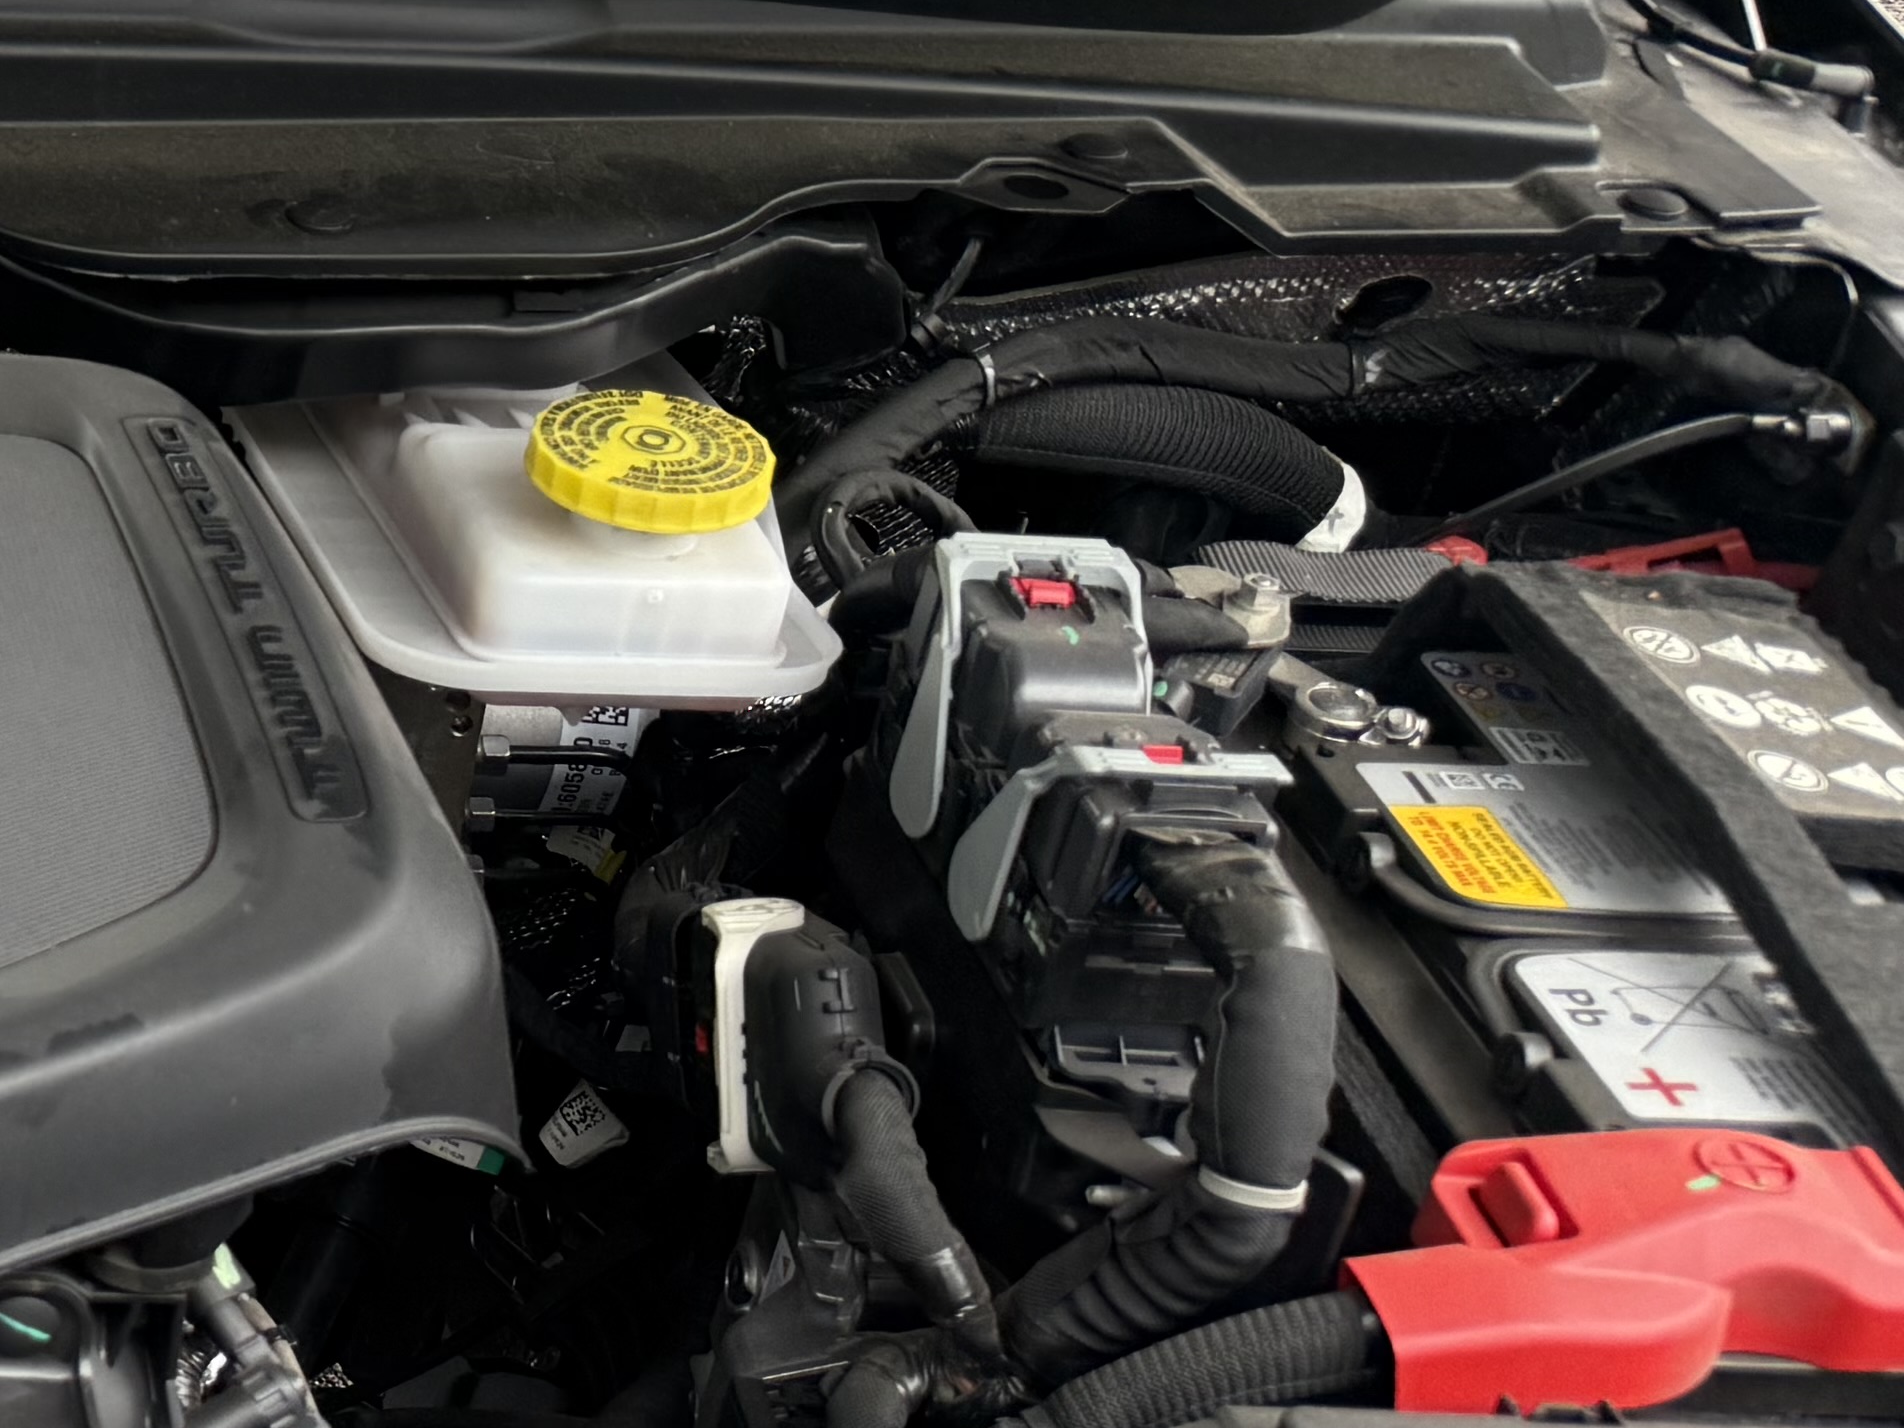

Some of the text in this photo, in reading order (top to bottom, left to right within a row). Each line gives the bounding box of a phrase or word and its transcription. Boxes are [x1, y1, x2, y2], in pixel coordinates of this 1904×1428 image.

[145, 418, 341, 803] TWIN TURBO
[1548, 988, 1608, 1027] Pb
